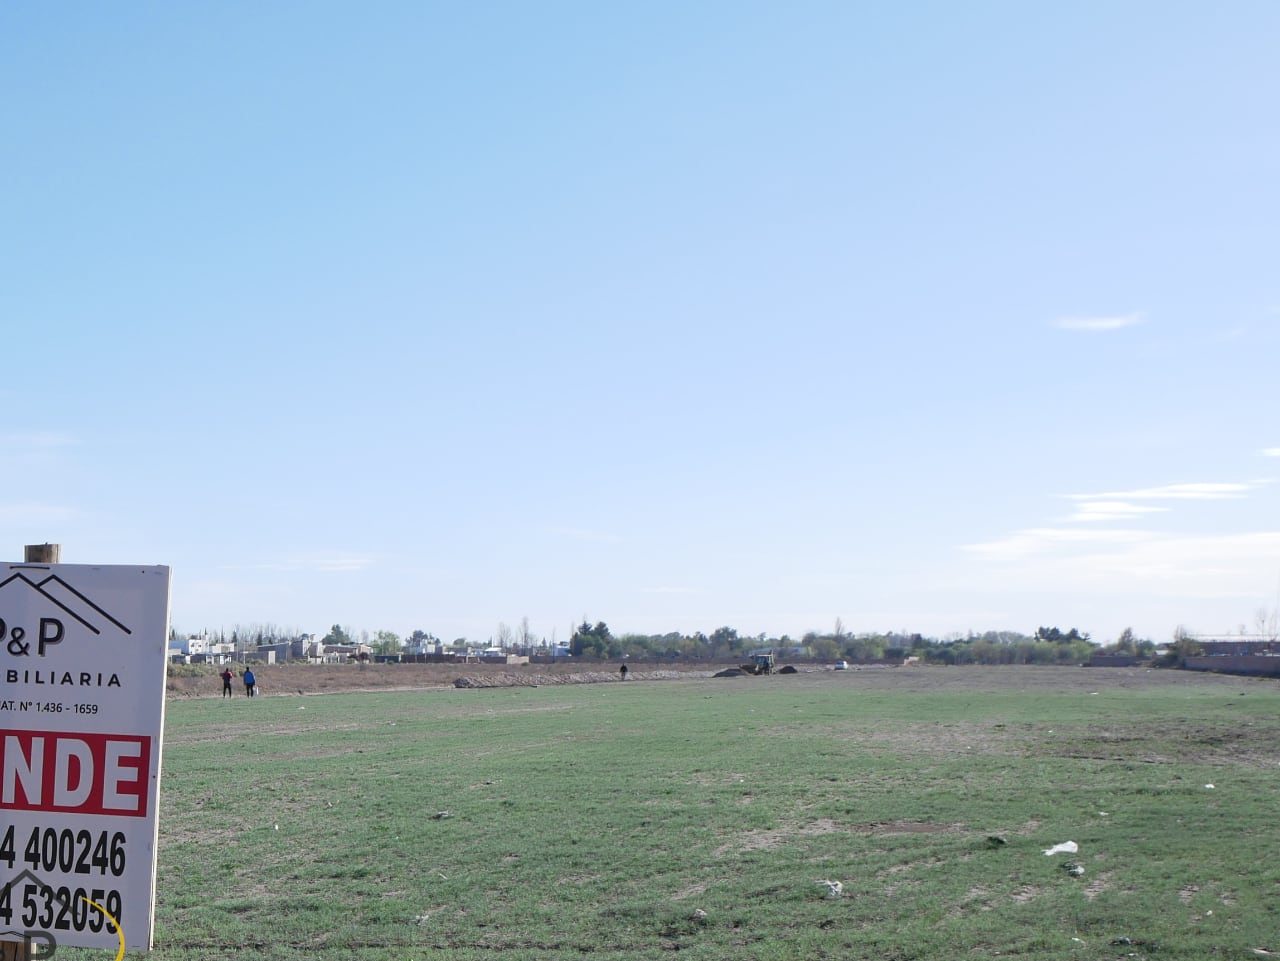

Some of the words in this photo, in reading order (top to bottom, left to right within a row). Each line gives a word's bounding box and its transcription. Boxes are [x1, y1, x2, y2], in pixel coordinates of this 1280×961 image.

[36, 702, 63, 713] 1.436
[74, 704, 98, 715] 1659
[24, 826, 127, 877] 400246
[21, 884, 122, 935] 532059
